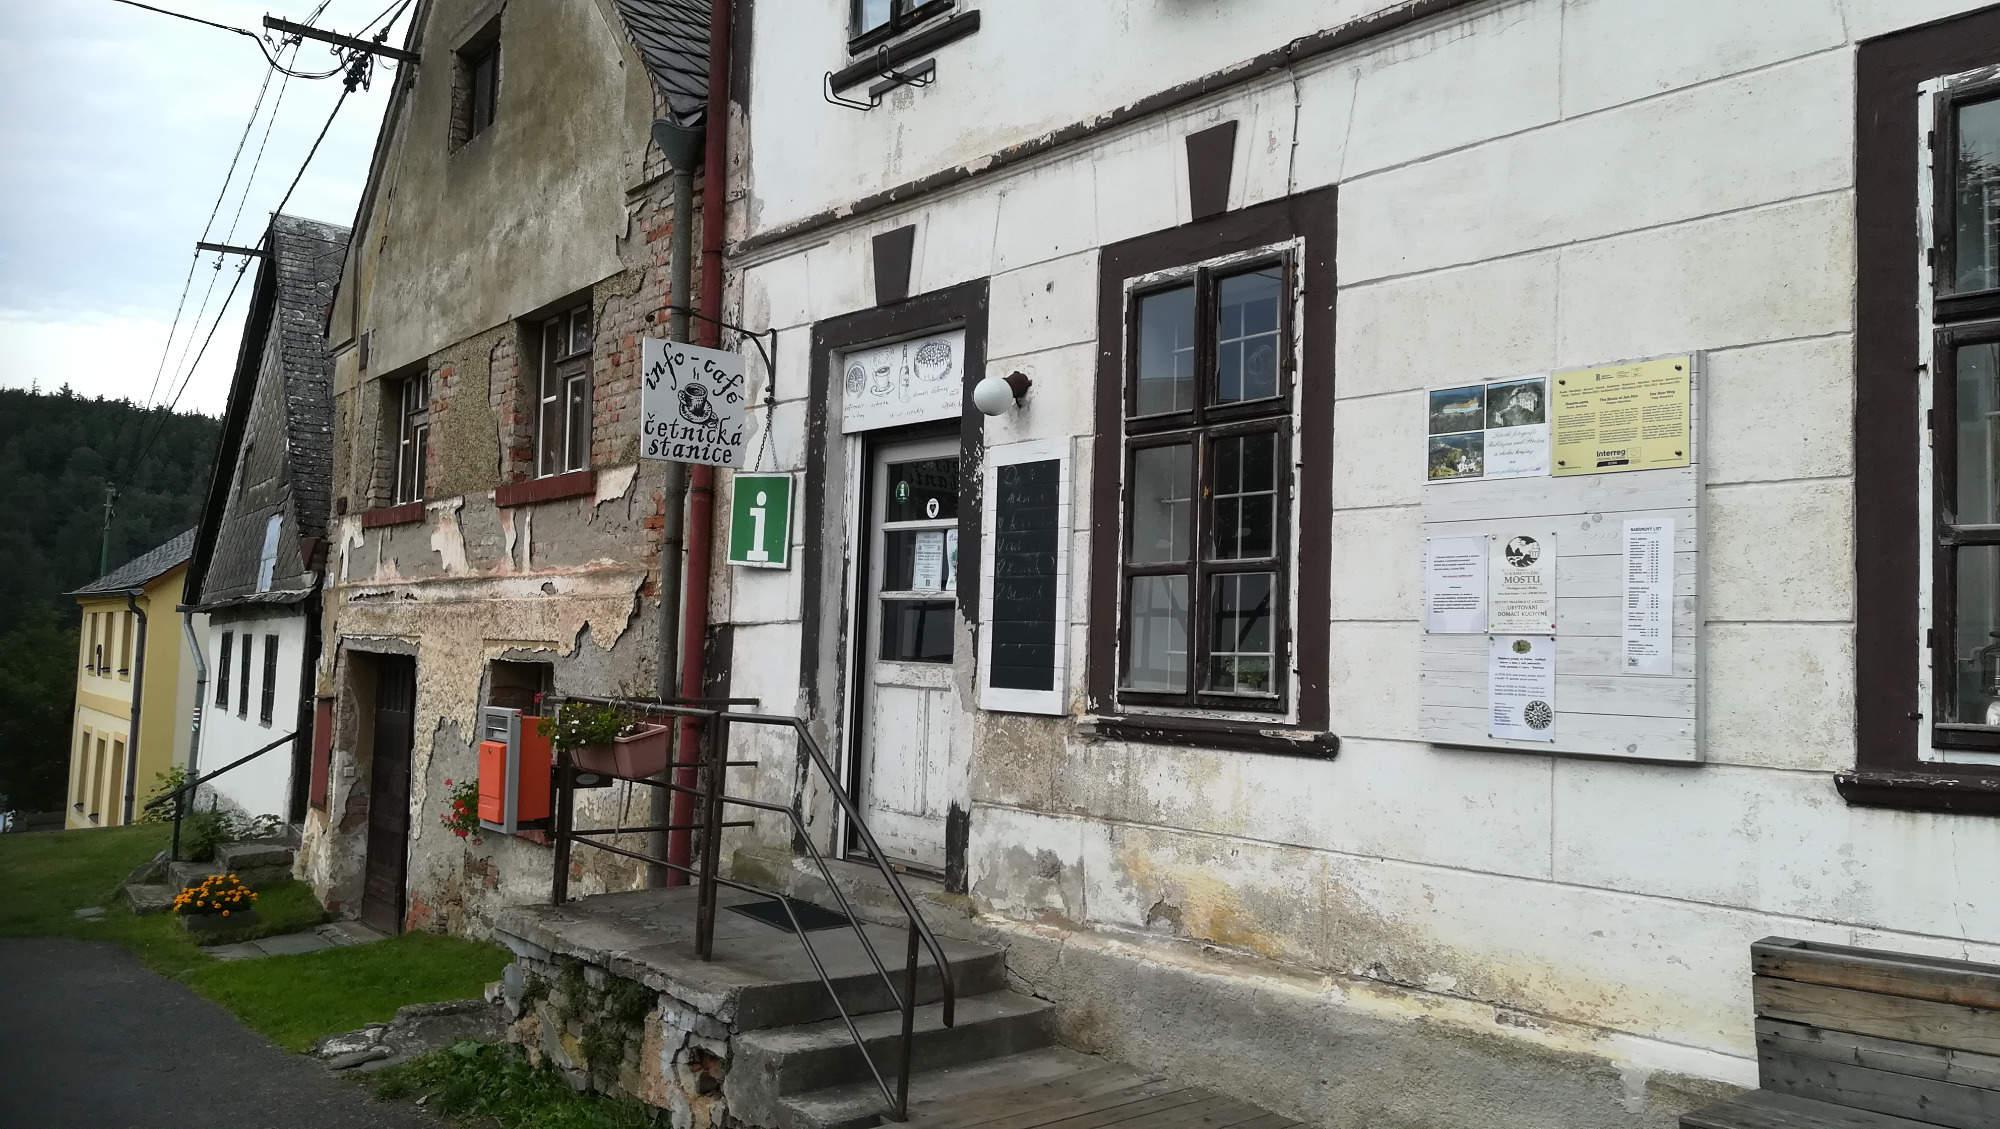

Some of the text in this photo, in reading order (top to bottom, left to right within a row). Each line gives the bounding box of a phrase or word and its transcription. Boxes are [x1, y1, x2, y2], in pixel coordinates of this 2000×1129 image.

[645, 412, 743, 446] četnická
[648, 437, 732, 463] stanice
[1596, 449, 1626, 457] Interreg
[747, 491, 769, 561] i
[1504, 575, 1540, 584] MOSTU
